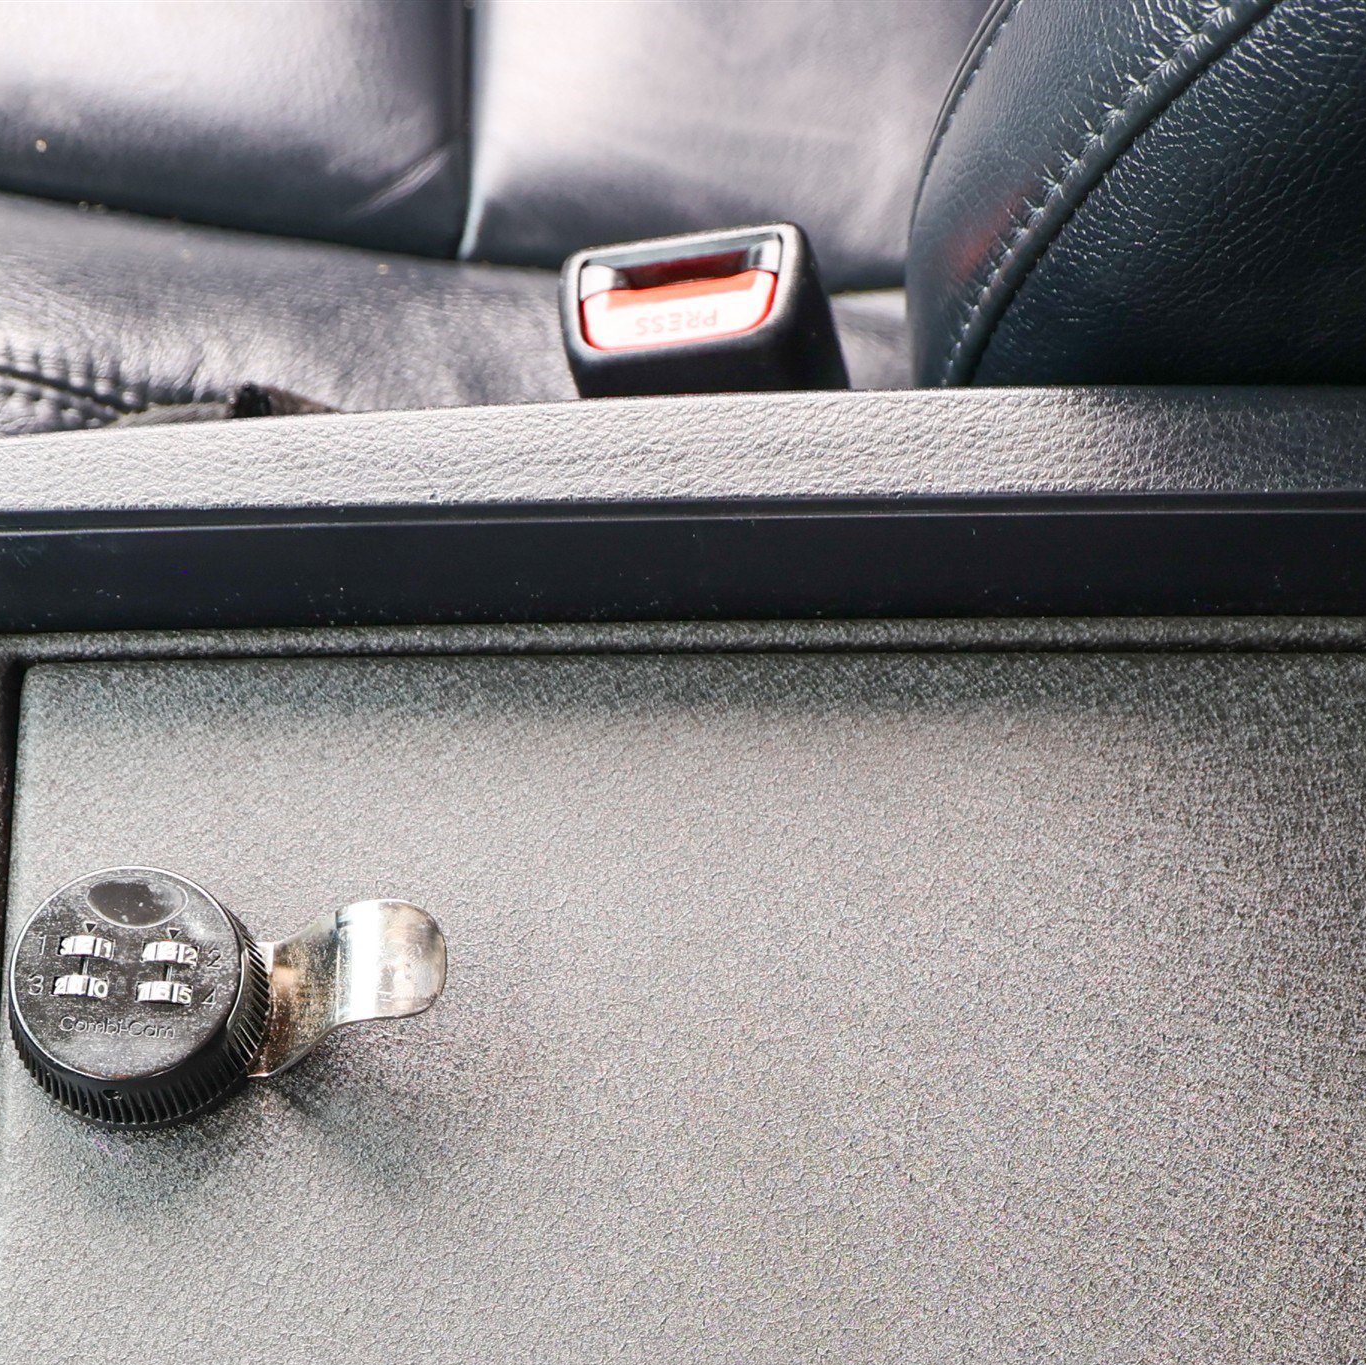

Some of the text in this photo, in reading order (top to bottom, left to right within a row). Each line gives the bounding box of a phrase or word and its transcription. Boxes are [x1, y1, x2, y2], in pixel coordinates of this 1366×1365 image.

[635, 309, 718, 336] PRESS
[206, 949, 223, 970] 2
[28, 975, 44, 997] 3
[201, 987, 218, 1006] 4
[60, 1016, 176, 1039] Combi-Cam
